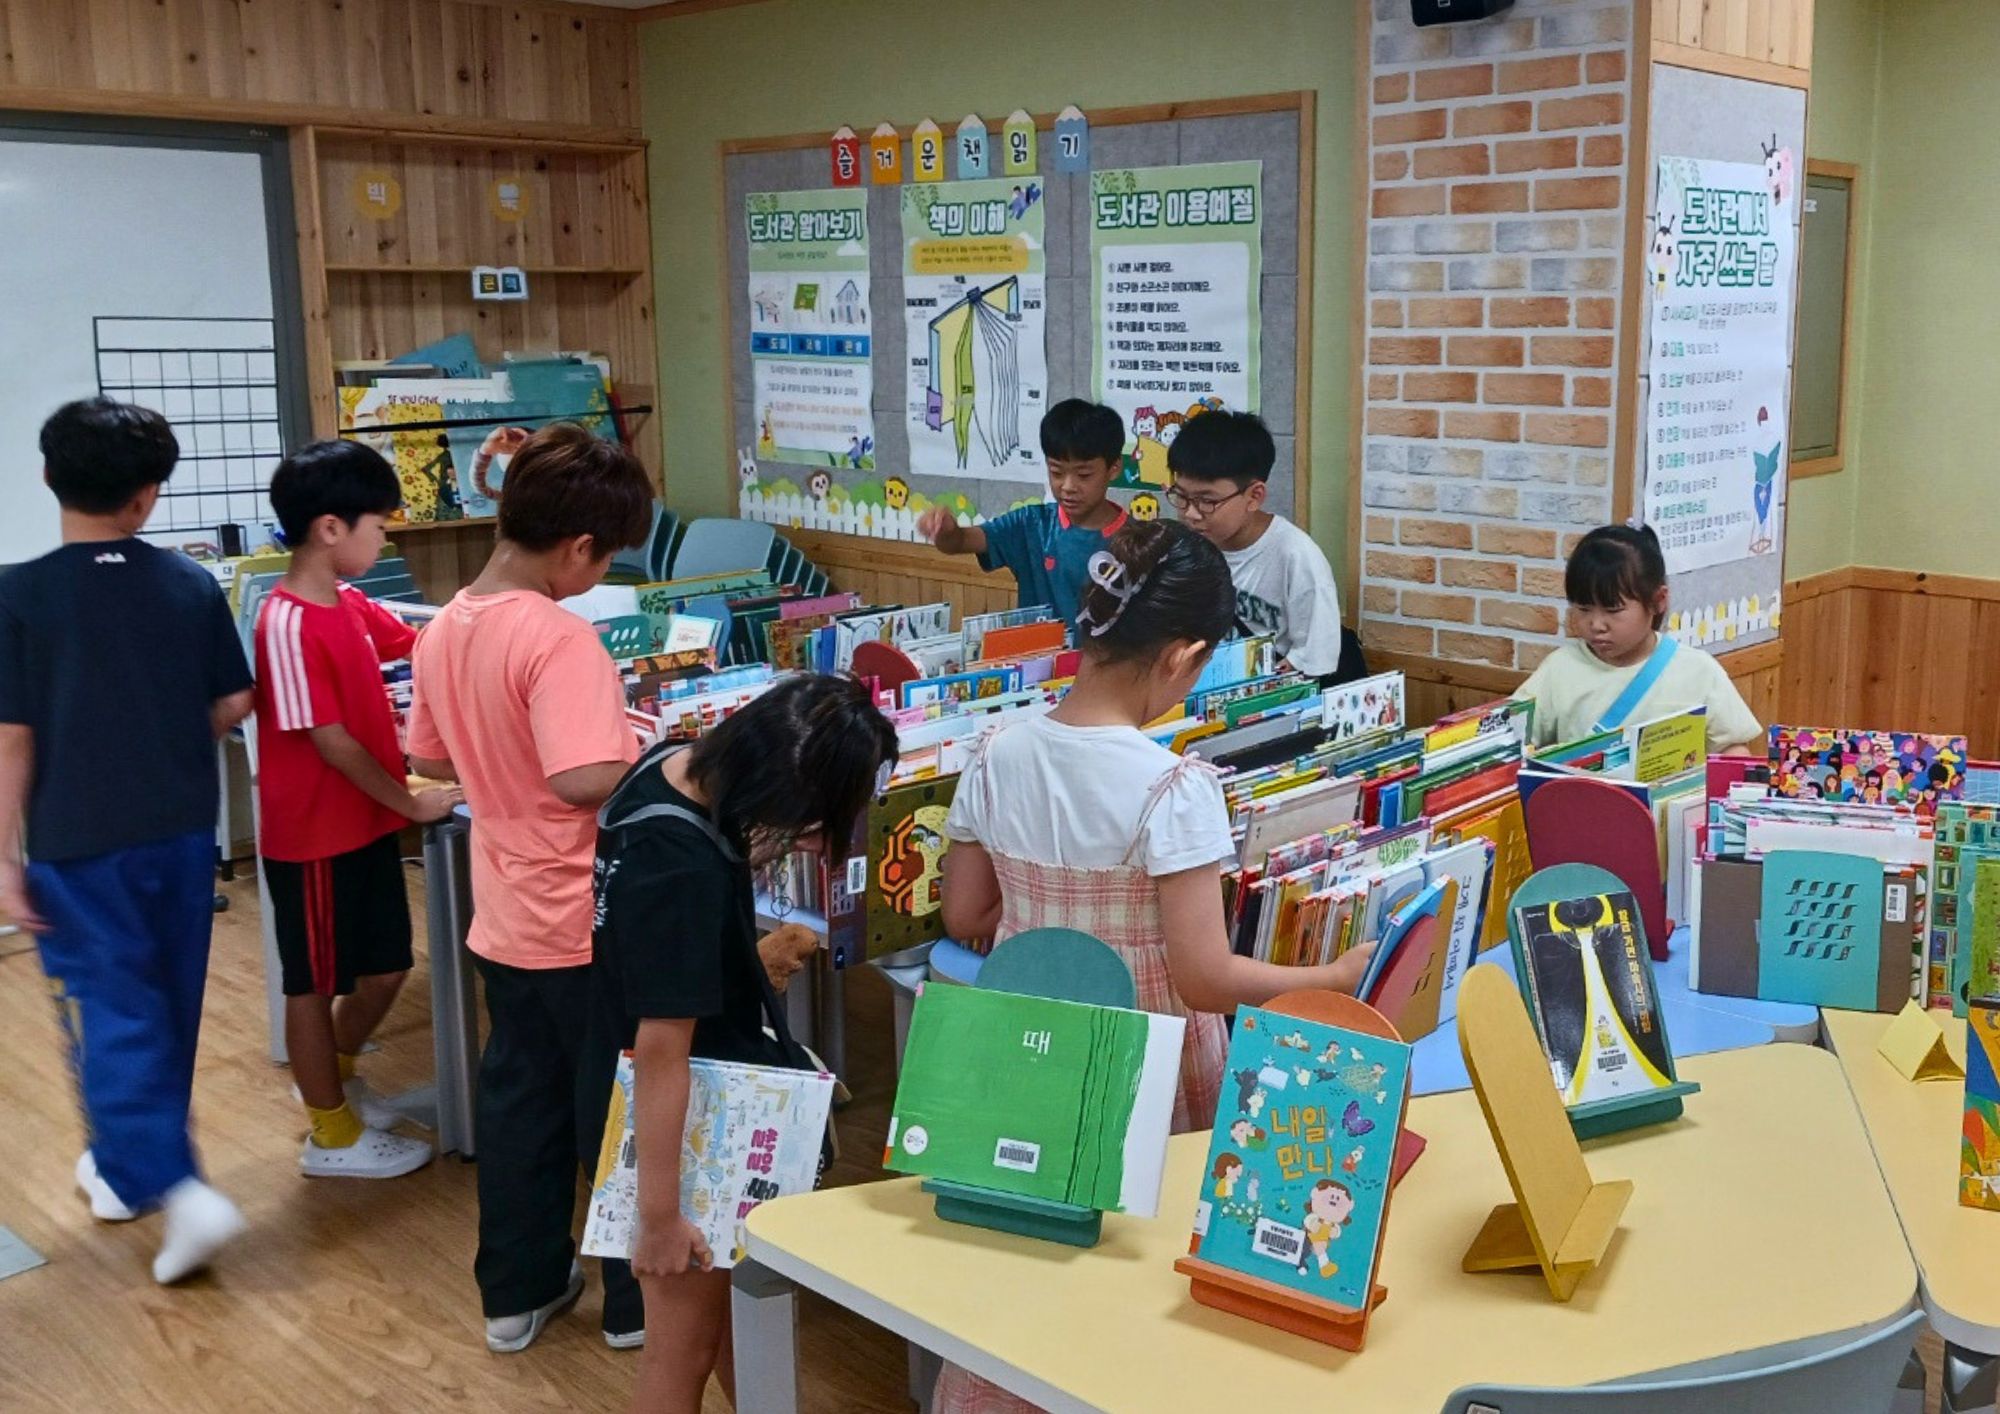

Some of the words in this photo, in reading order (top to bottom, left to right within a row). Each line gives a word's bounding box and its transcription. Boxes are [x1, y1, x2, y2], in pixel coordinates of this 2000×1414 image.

[750, 211, 796, 241] 도서관
[798, 209, 863, 241] 알아보기
[929, 202, 965, 235] 책의
[969, 201, 1007, 234] 이해
[1097, 190, 1160, 229] 도서관
[1166, 186, 1255, 226] 이용예절
[1682, 187, 1769, 236] 도서관에서
[1676, 241, 1716, 287] 자주
[1718, 242, 1756, 286] 쓰는
[1759, 243, 1778, 286] 말
[1022, 1030, 1052, 1056] 때
[1271, 1104, 1327, 1141] 내일
[1275, 1144, 1333, 1181] 만나
